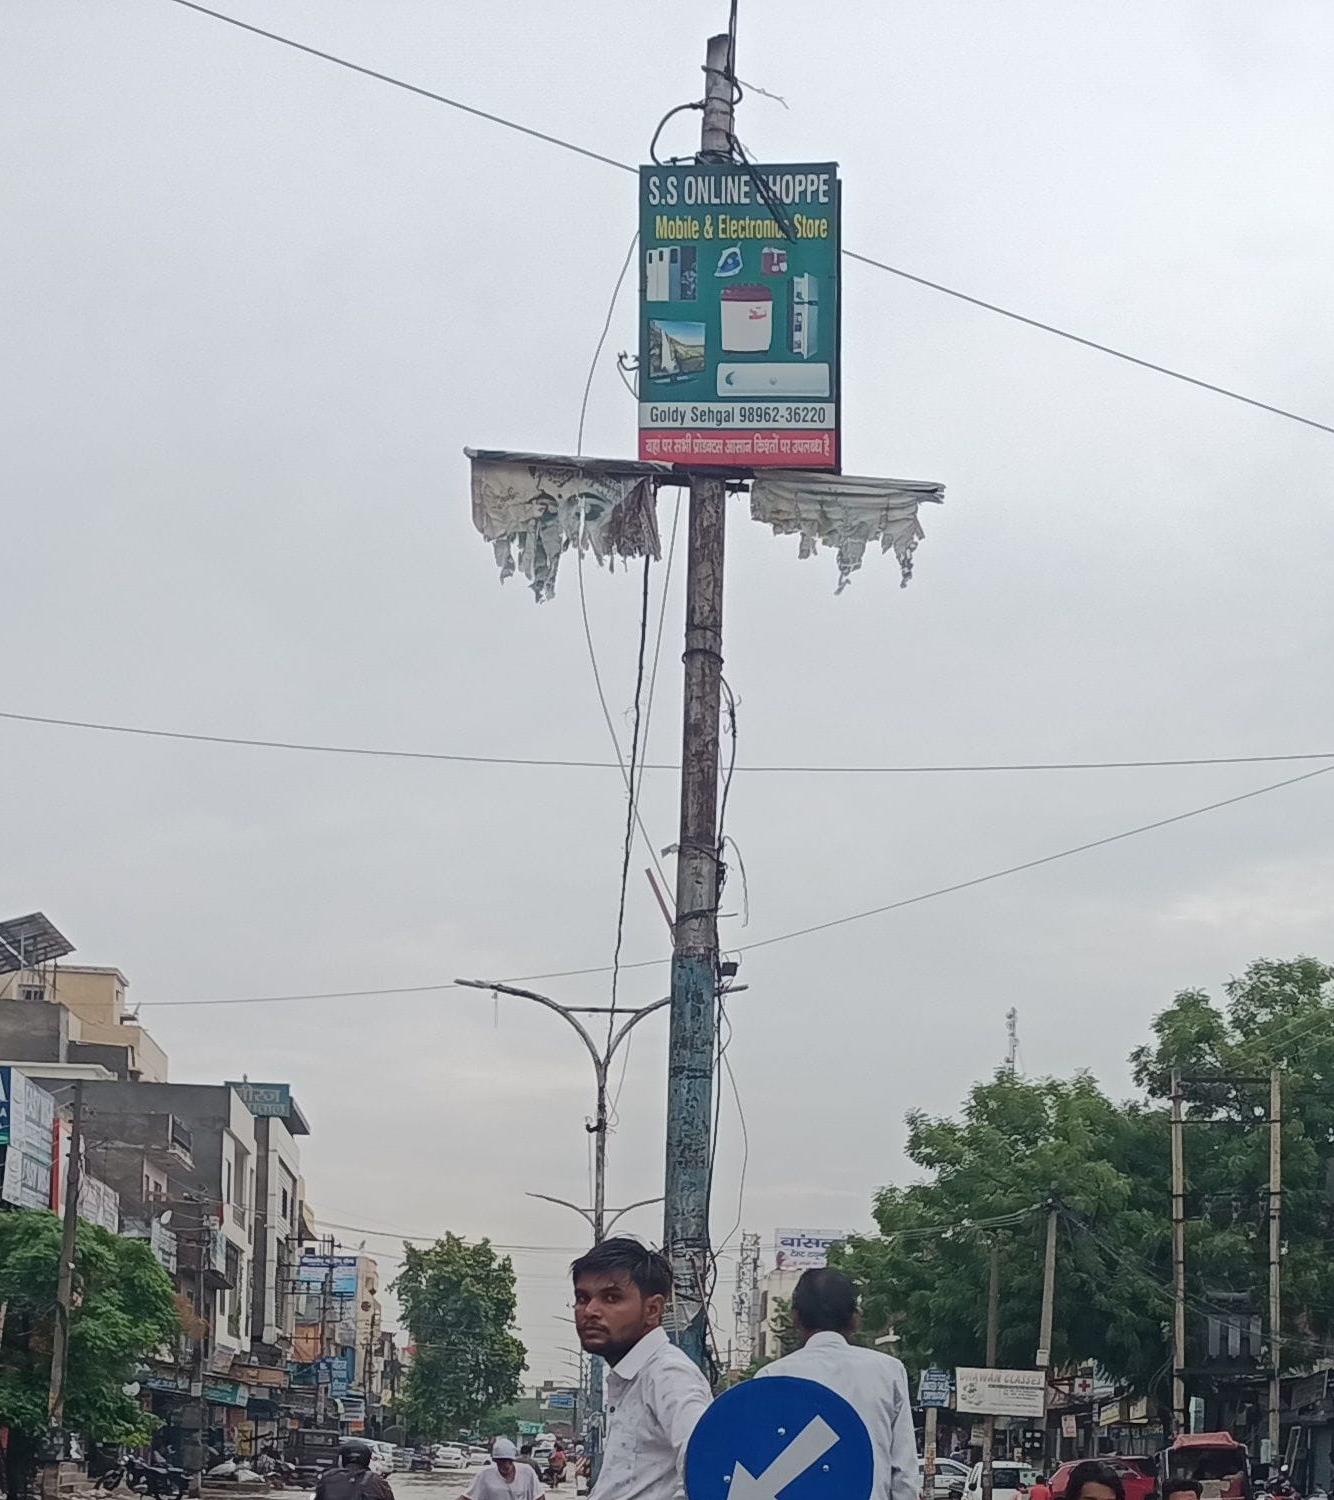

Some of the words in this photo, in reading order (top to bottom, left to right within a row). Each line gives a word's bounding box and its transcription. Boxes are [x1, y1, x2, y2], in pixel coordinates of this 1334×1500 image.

[684, 175, 751, 205] ONLINE
[656, 215, 700, 240] Mobile
[703, 218, 714, 238] &
[794, 213, 828, 239] Store
[650, 406, 687, 426] Goldy
[691, 406, 735, 427] Sehgal
[739, 406, 826, 423] 98962-36220
[662, 438, 673, 454] पर
[780, 438, 791, 454] पर
